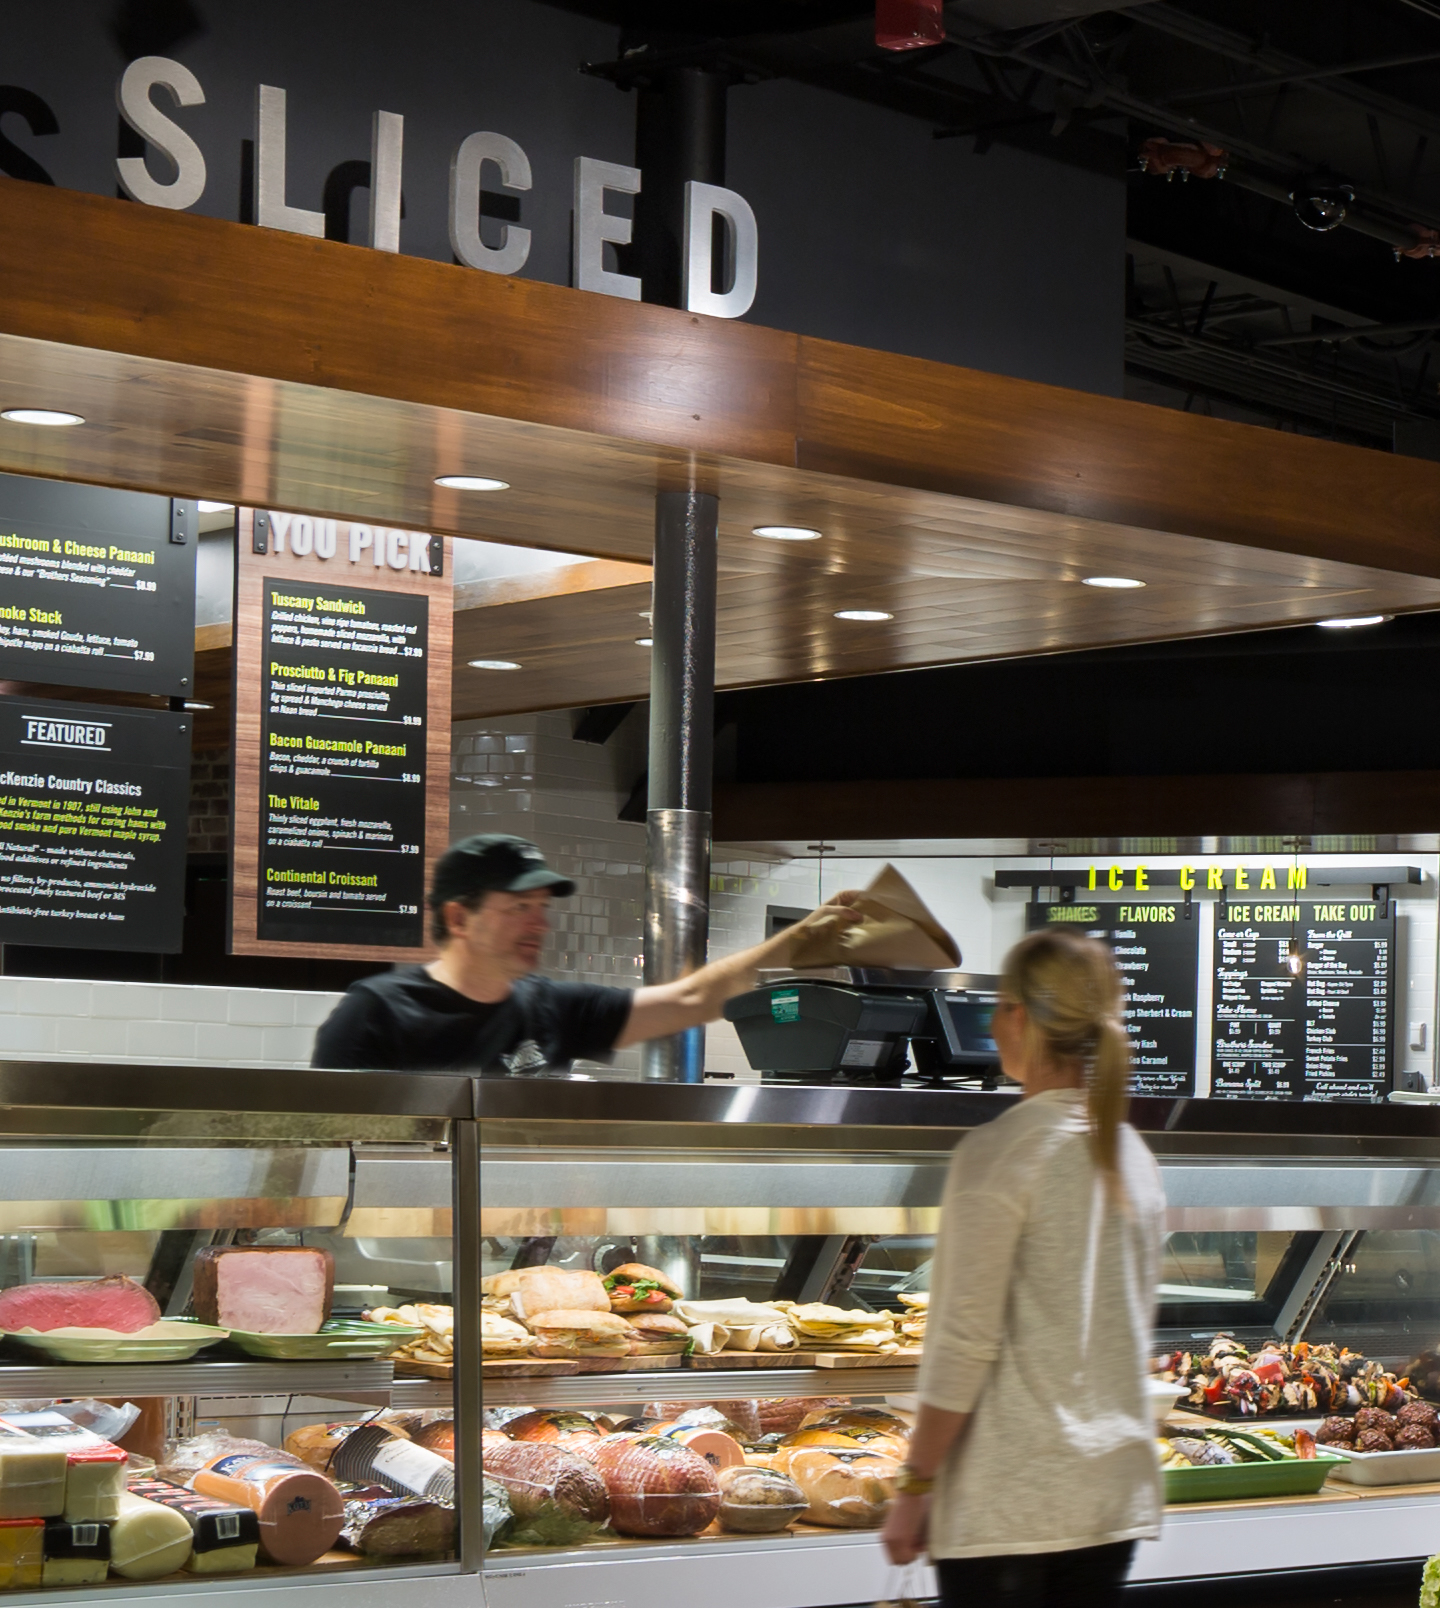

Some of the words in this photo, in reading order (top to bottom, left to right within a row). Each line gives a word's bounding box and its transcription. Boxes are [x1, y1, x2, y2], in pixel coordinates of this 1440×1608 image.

[115, 55, 759, 319] SLICED
[52, 538, 62, 554] &
[64, 540, 107, 559] Cheese
[108, 545, 155, 565] Panaani
[268, 511, 336, 559] YOU
[349, 522, 431, 573] PICK
[270, 591, 315, 612] Tuscany
[315, 596, 366, 615] Sandwich
[28, 607, 62, 625] Stack
[270, 661, 326, 680] Prosciutto
[327, 667, 336, 681] &
[338, 668, 355, 686] Fig
[356, 670, 398, 687] Panaani
[27, 720, 105, 746] FEATURED
[269, 732, 303, 748] Bacon
[305, 735, 363, 753] Guacamole
[365, 740, 406, 756] Panaani
[47, 774, 93, 794] Country
[94, 778, 142, 796] Classics
[268, 794, 287, 809] The
[289, 795, 319, 811] Vitale
[266, 867, 326, 884] Continental
[328, 871, 377, 887] Croissant
[1088, 864, 1149, 891] ICE
[1180, 863, 1307, 891] CREAM
[1048, 906, 1097, 923] SHAKES
[1119, 906, 1176, 922] FLAVORS
[1228, 905, 1250, 922] ICE
[1254, 905, 1300, 922] CREAM
[1313, 905, 1346, 921] TAKE
[1350, 905, 1376, 921] OUT
